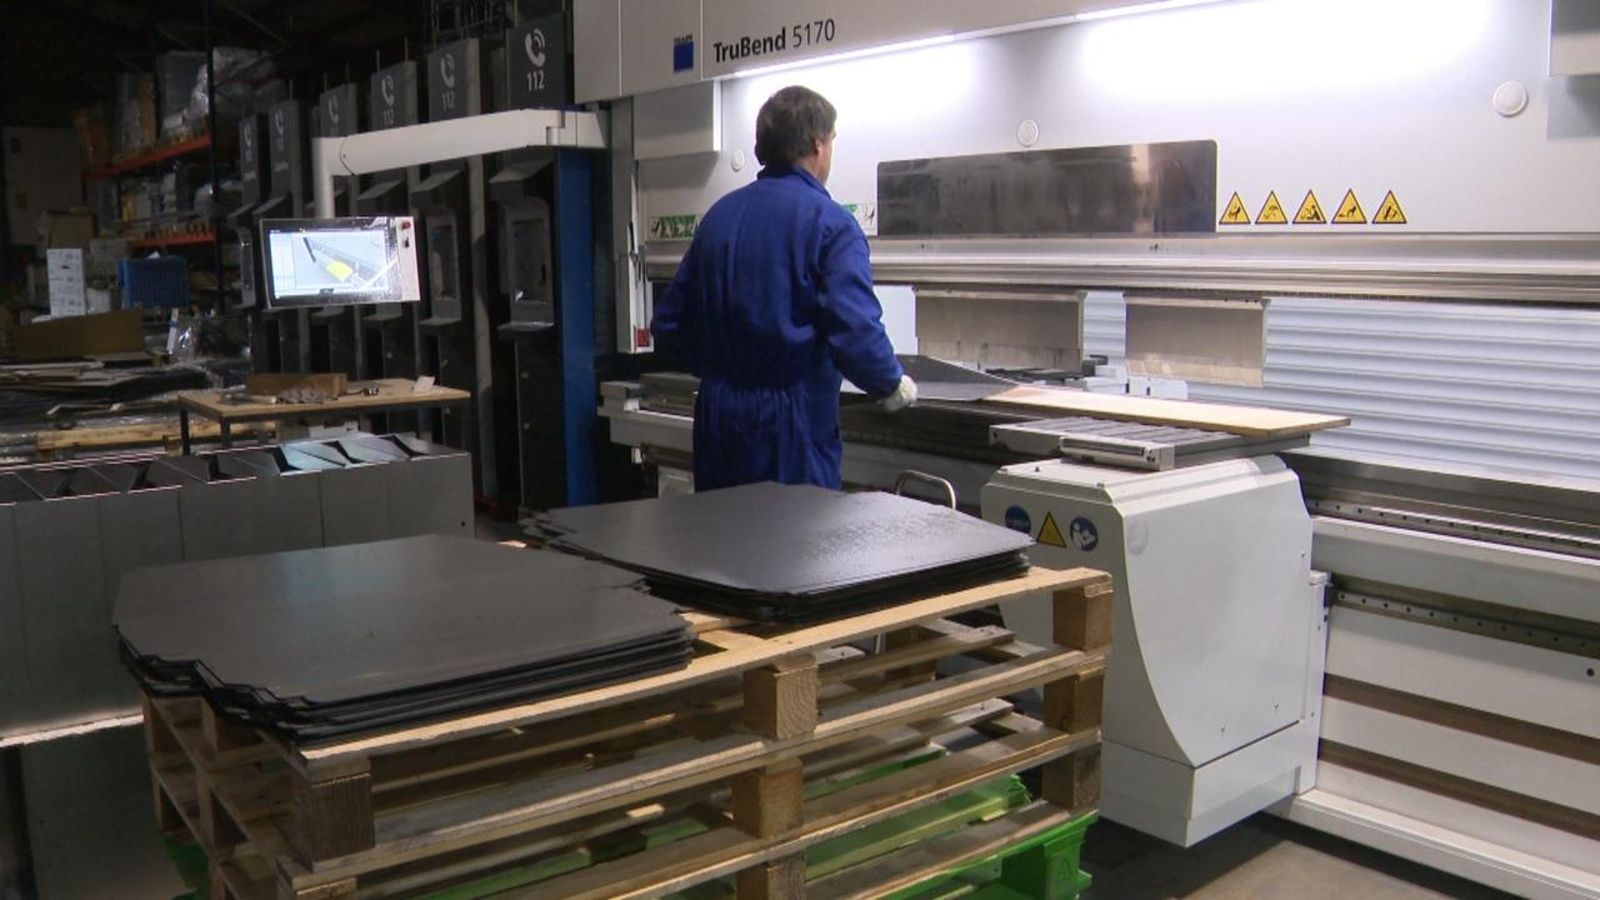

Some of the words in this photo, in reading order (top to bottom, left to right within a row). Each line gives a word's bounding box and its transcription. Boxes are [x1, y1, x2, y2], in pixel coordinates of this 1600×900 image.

[713, 26, 786, 63] TruBend
[792, 18, 836, 49] 5170
[527, 70, 545, 91] 112
